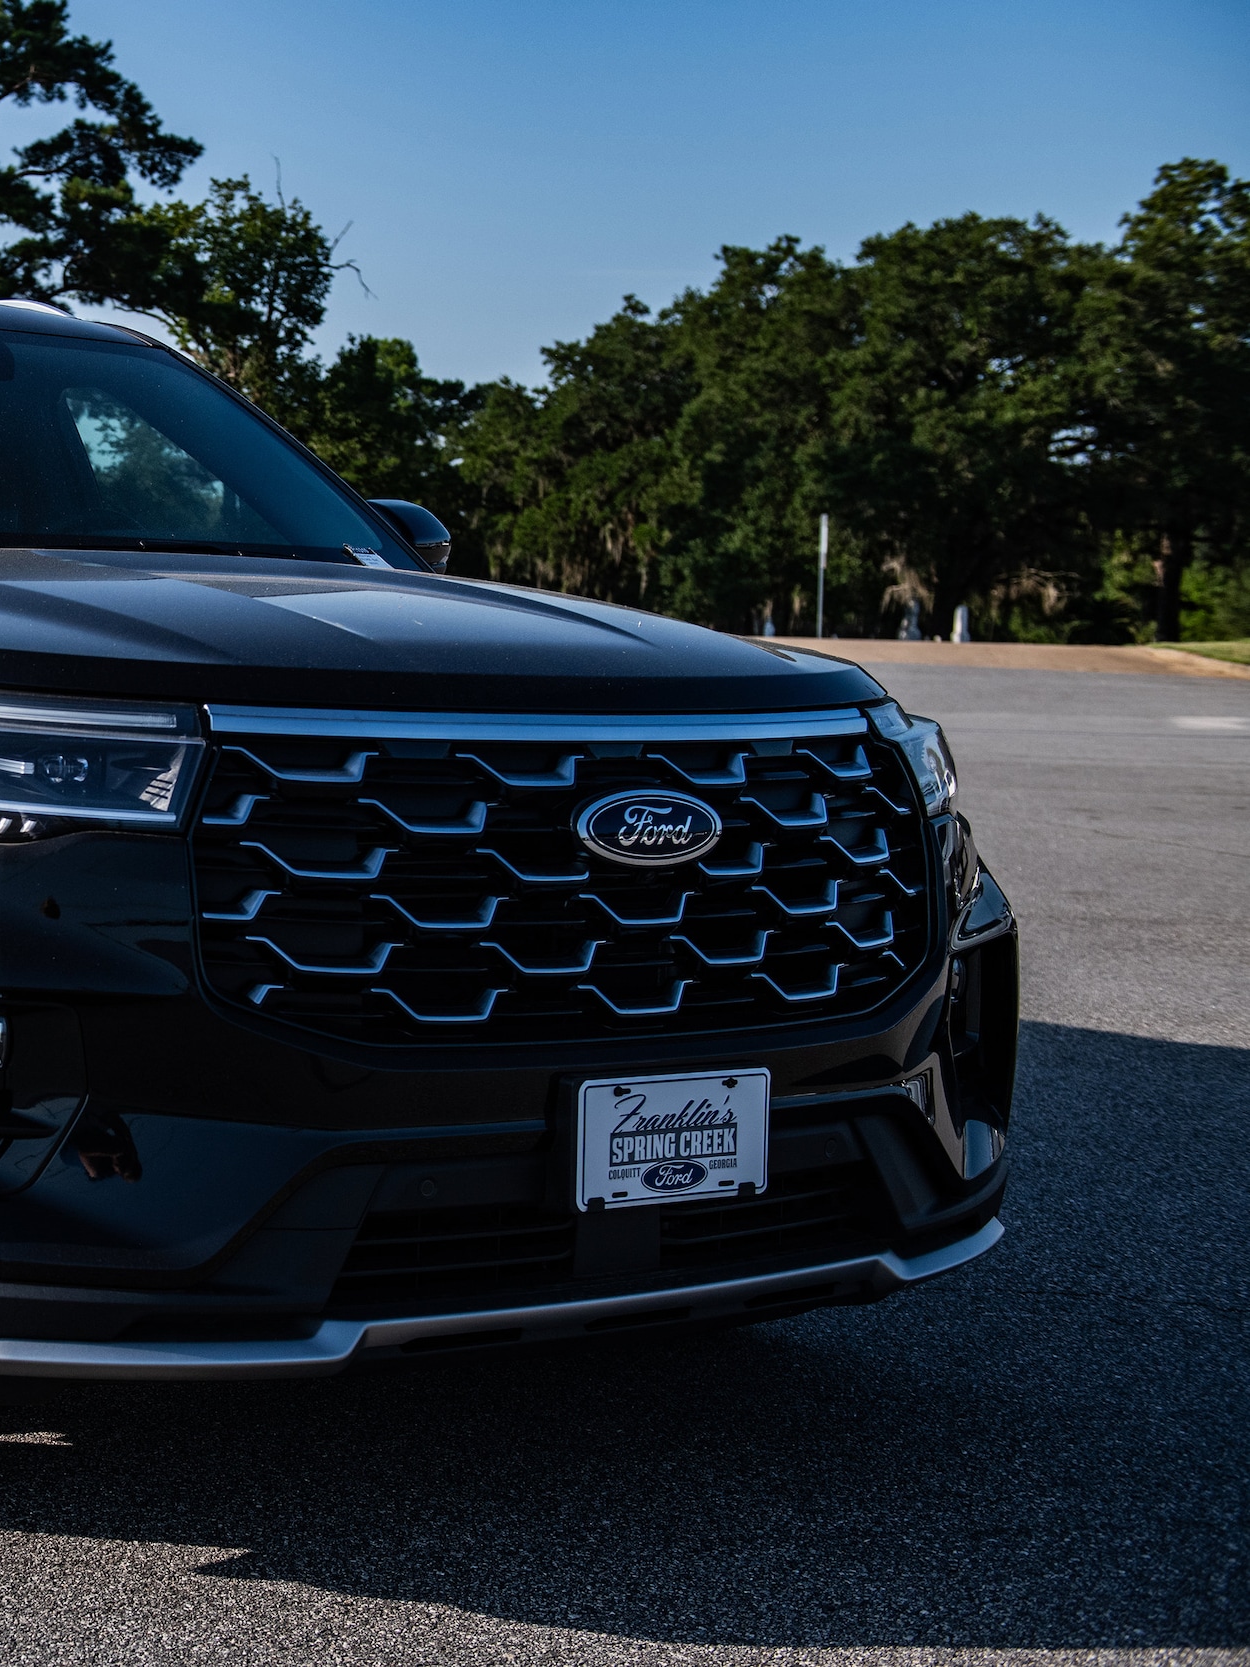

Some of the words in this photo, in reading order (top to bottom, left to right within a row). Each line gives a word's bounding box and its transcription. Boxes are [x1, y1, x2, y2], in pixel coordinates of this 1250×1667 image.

[618, 805, 693, 847] Ford
[614, 1093, 737, 1134] Franklin's
[611, 1132, 676, 1165] SPRING
[679, 1127, 737, 1158] CREEK
[608, 1166, 642, 1181] COLQUITT
[654, 1163, 694, 1187] Ford
[708, 1157, 738, 1170] GEORGIA
